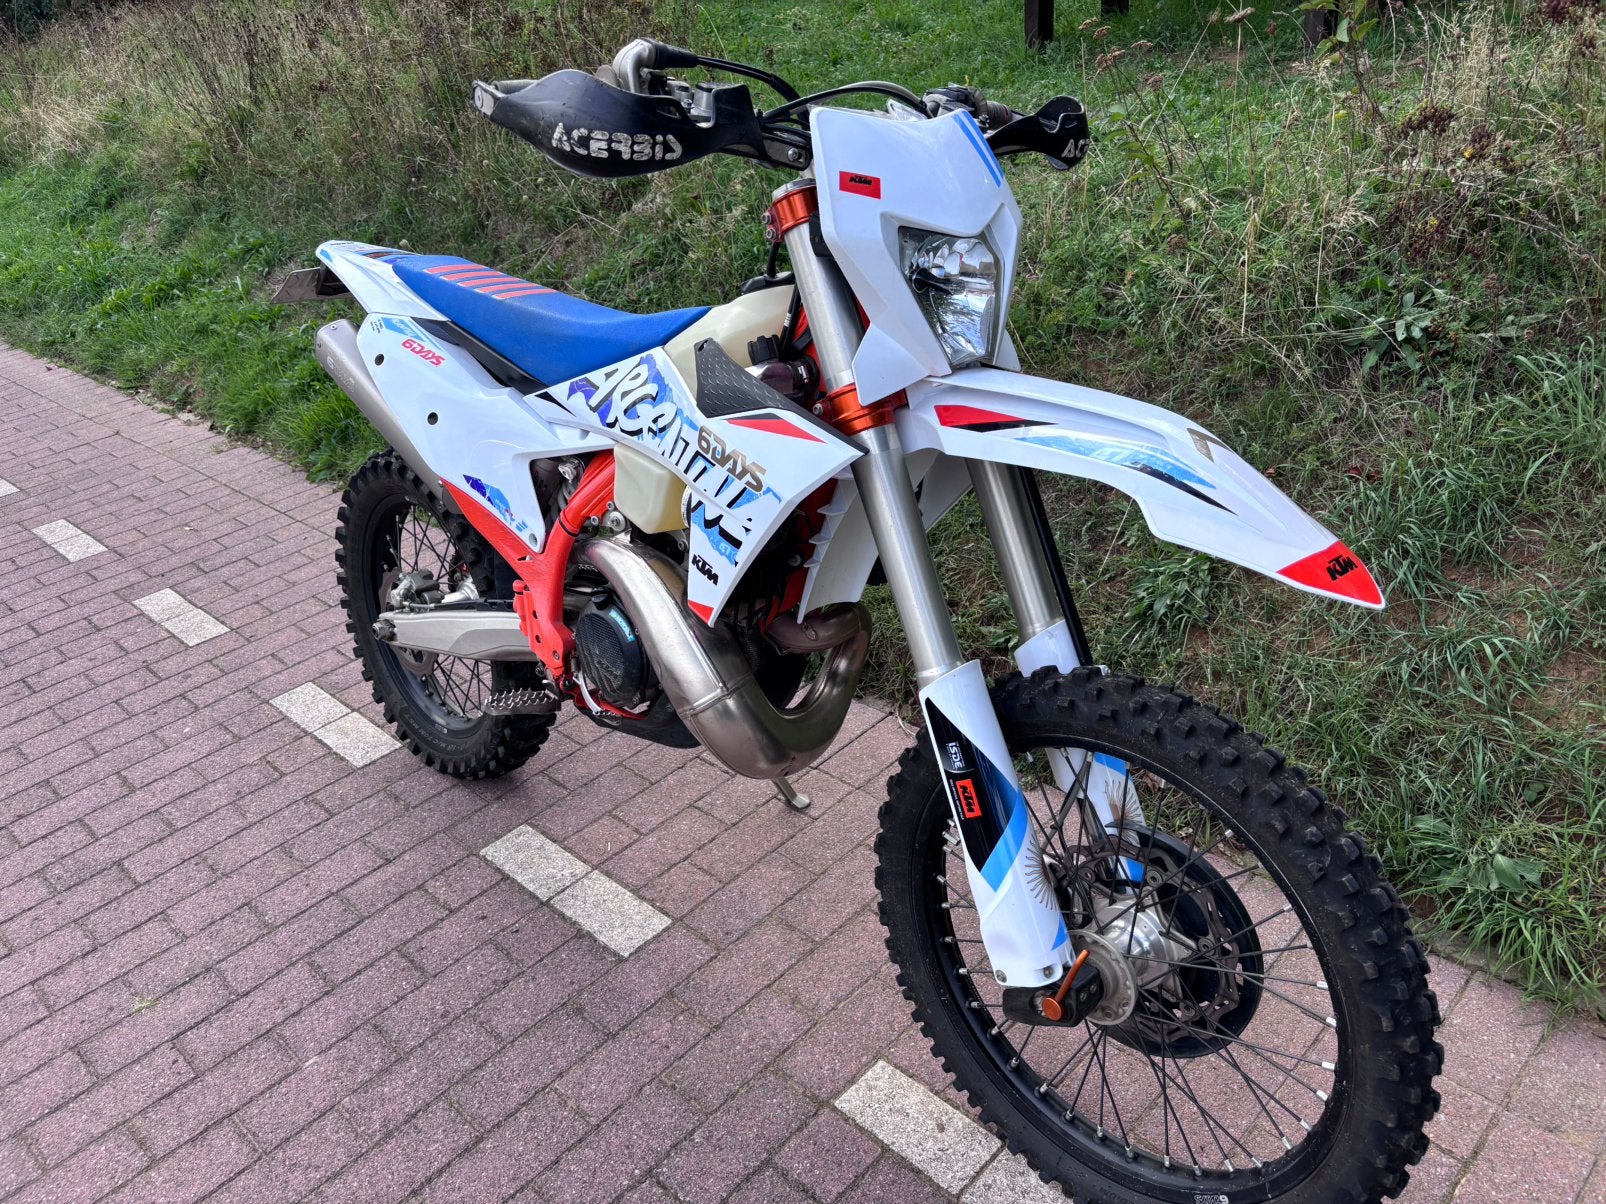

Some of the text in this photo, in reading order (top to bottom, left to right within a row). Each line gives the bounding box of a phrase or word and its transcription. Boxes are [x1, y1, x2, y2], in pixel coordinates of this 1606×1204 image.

[401, 338, 446, 367] 6DAYS
[696, 424, 767, 493] 6DAYS
[691, 553, 720, 586] KTM
[1325, 554, 1359, 582] KTM
[948, 741, 963, 769] ISDE
[959, 784, 976, 813] KTM
